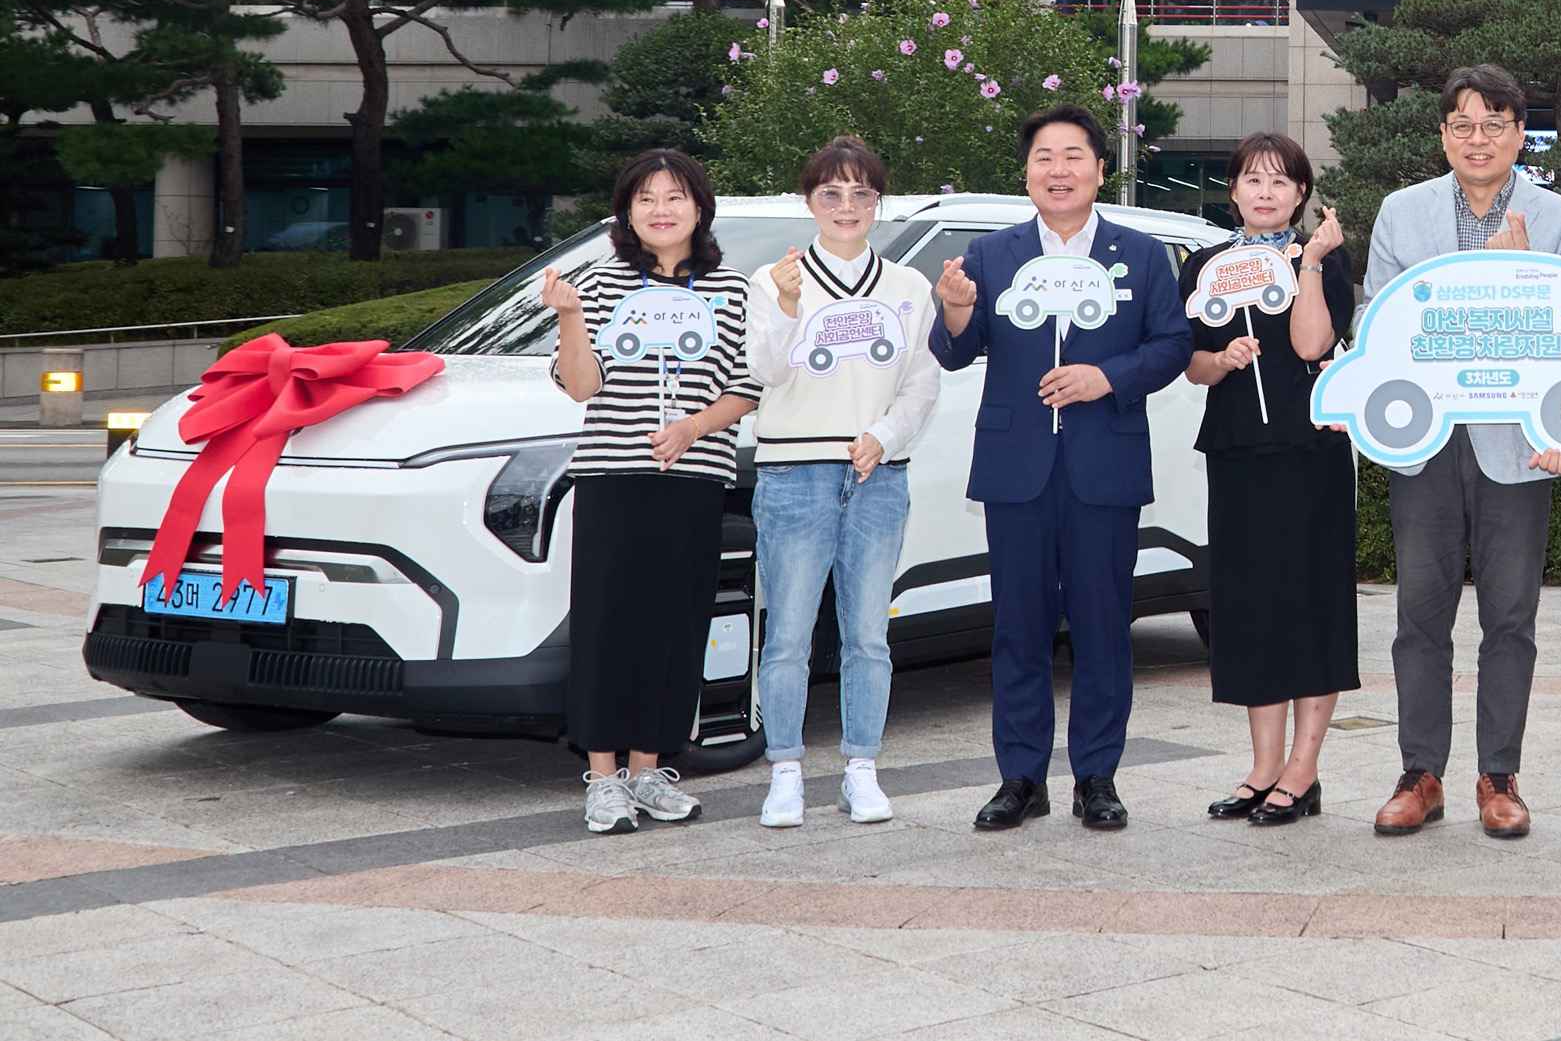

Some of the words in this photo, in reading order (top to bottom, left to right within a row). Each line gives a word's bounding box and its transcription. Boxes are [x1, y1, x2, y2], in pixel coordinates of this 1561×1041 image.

[1437, 285, 1496, 301] 삼성전자
[1500, 284, 1553, 300] DS부문
[1422, 307, 1465, 333] 아산
[1468, 307, 1553, 333] 복지시설
[1411, 334, 1475, 360] 친환경
[1465, 371, 1512, 385] 3차년도
